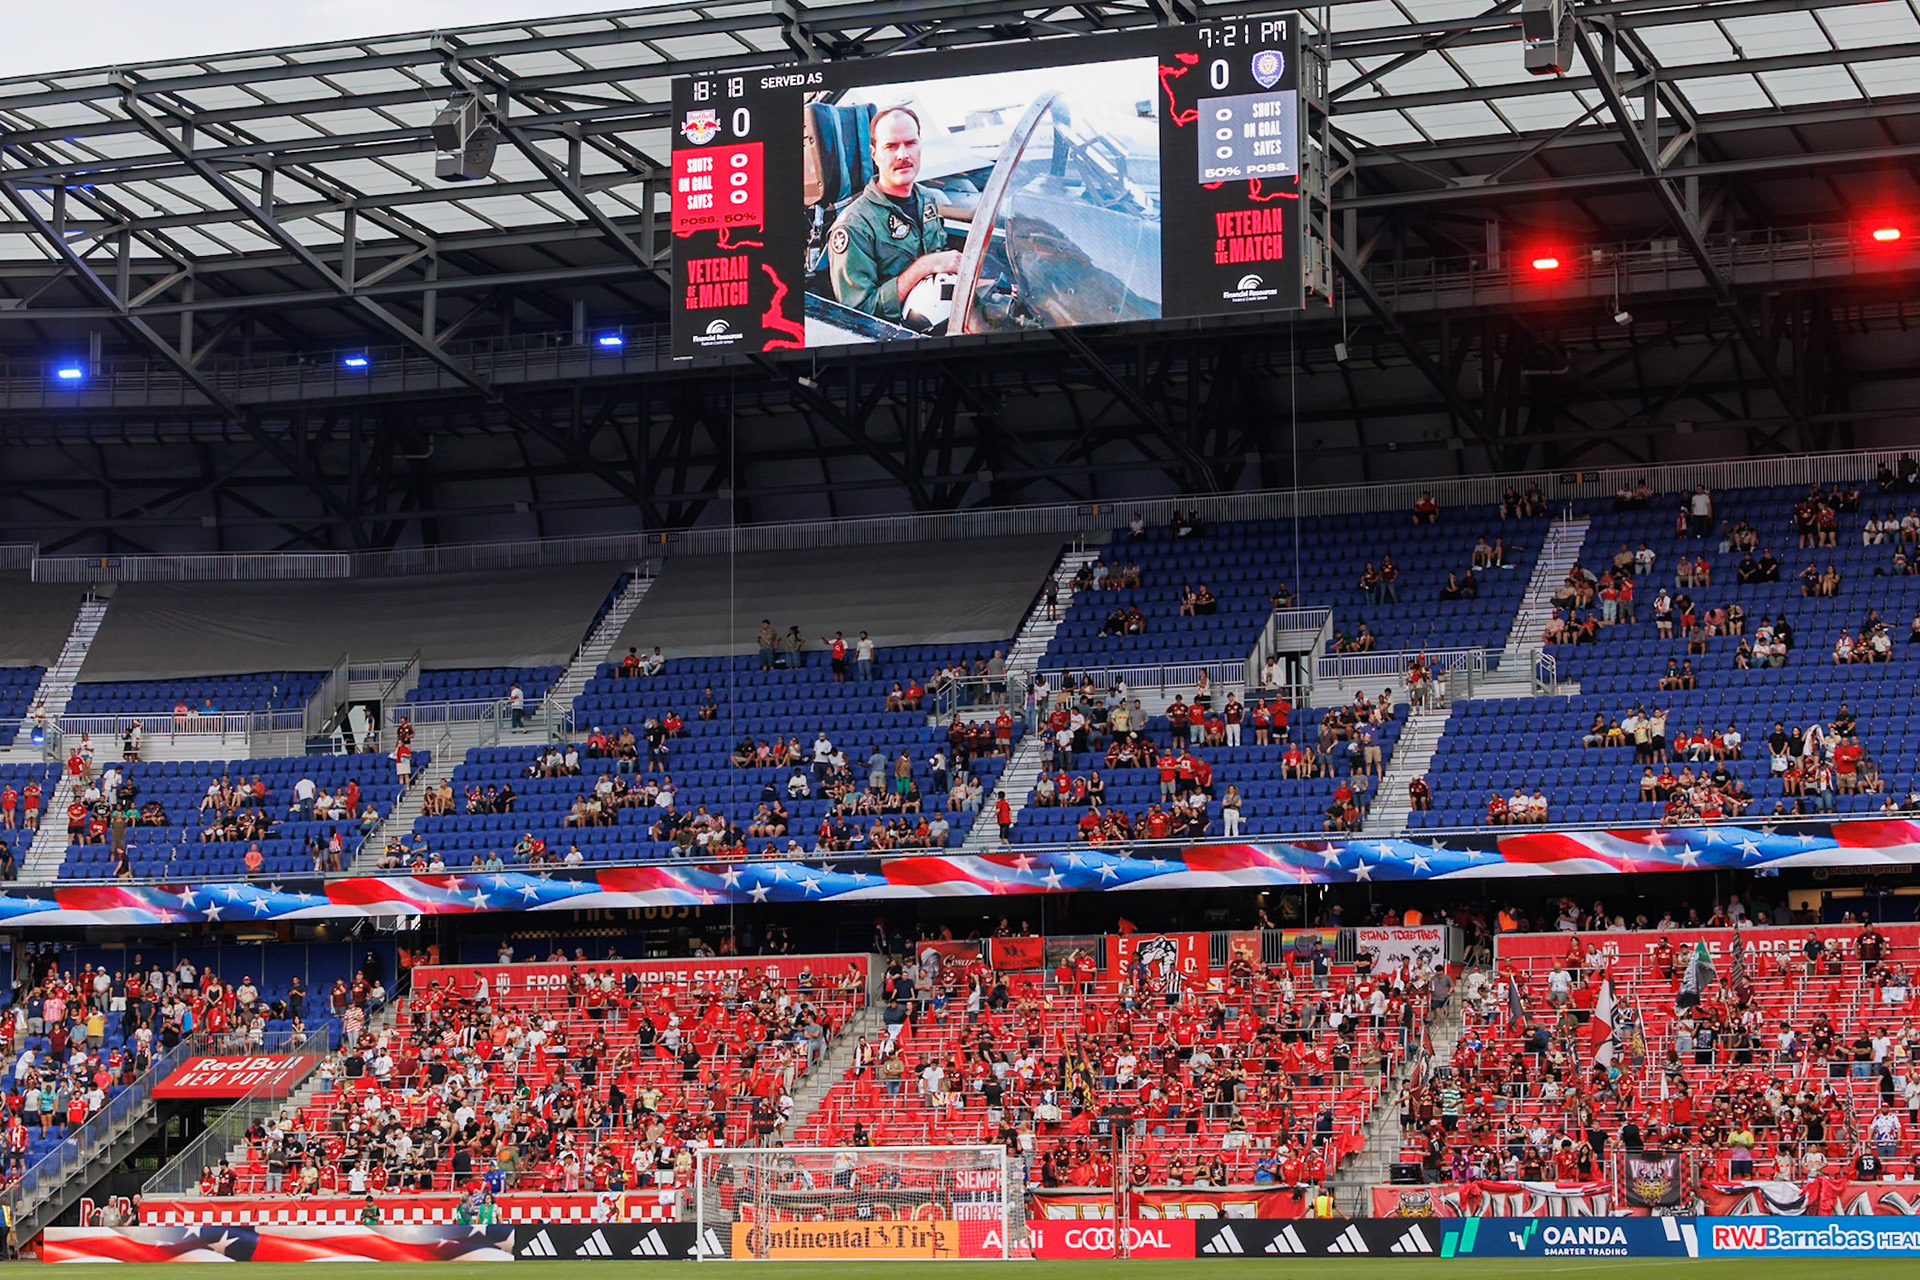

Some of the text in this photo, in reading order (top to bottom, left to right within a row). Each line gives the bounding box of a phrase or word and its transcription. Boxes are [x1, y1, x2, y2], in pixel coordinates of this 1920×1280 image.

[1199, 20, 1287, 48] 7:21 PM
[760, 72, 824, 89] SERVED AS
[1210, 58, 1230, 90] 0
[1216, 101, 1282, 121] 0 SHOTS
[732, 108, 750, 138] 0
[1216, 120, 1282, 140] 0 ON GOAL
[1216, 140, 1282, 159] 0 SAVES
[686, 154, 748, 174] SHOTS 0
[1204, 162, 1290, 178] 50% POSS.
[678, 172, 748, 192] ON GOAL 0
[687, 190, 748, 210] SAVES 0
[680, 212, 756, 226] POSS. 50%
[1216, 208, 1282, 238] VETERAN
[1215, 234, 1283, 264] THE MATCH
[1216, 239, 1226, 252] OF
[687, 255, 748, 284] VETERAN
[686, 280, 748, 310] THE MATCH
[687, 285, 696, 298] OF
[1223, 288, 1278, 298] Financial Resources
[1360, 929, 1440, 942] STAND TOGETHER
[622, 971, 688, 988] MPIRE
[192, 1056, 304, 1071] Red Bull
[174, 1072, 227, 1086] NEW
[1862, 1160, 1874, 1170] 13
[982, 1230, 1043, 1249] Adi
[1543, 1226, 1628, 1246] OANDA
[1715, 1226, 1873, 1248] RWJBarnabas
